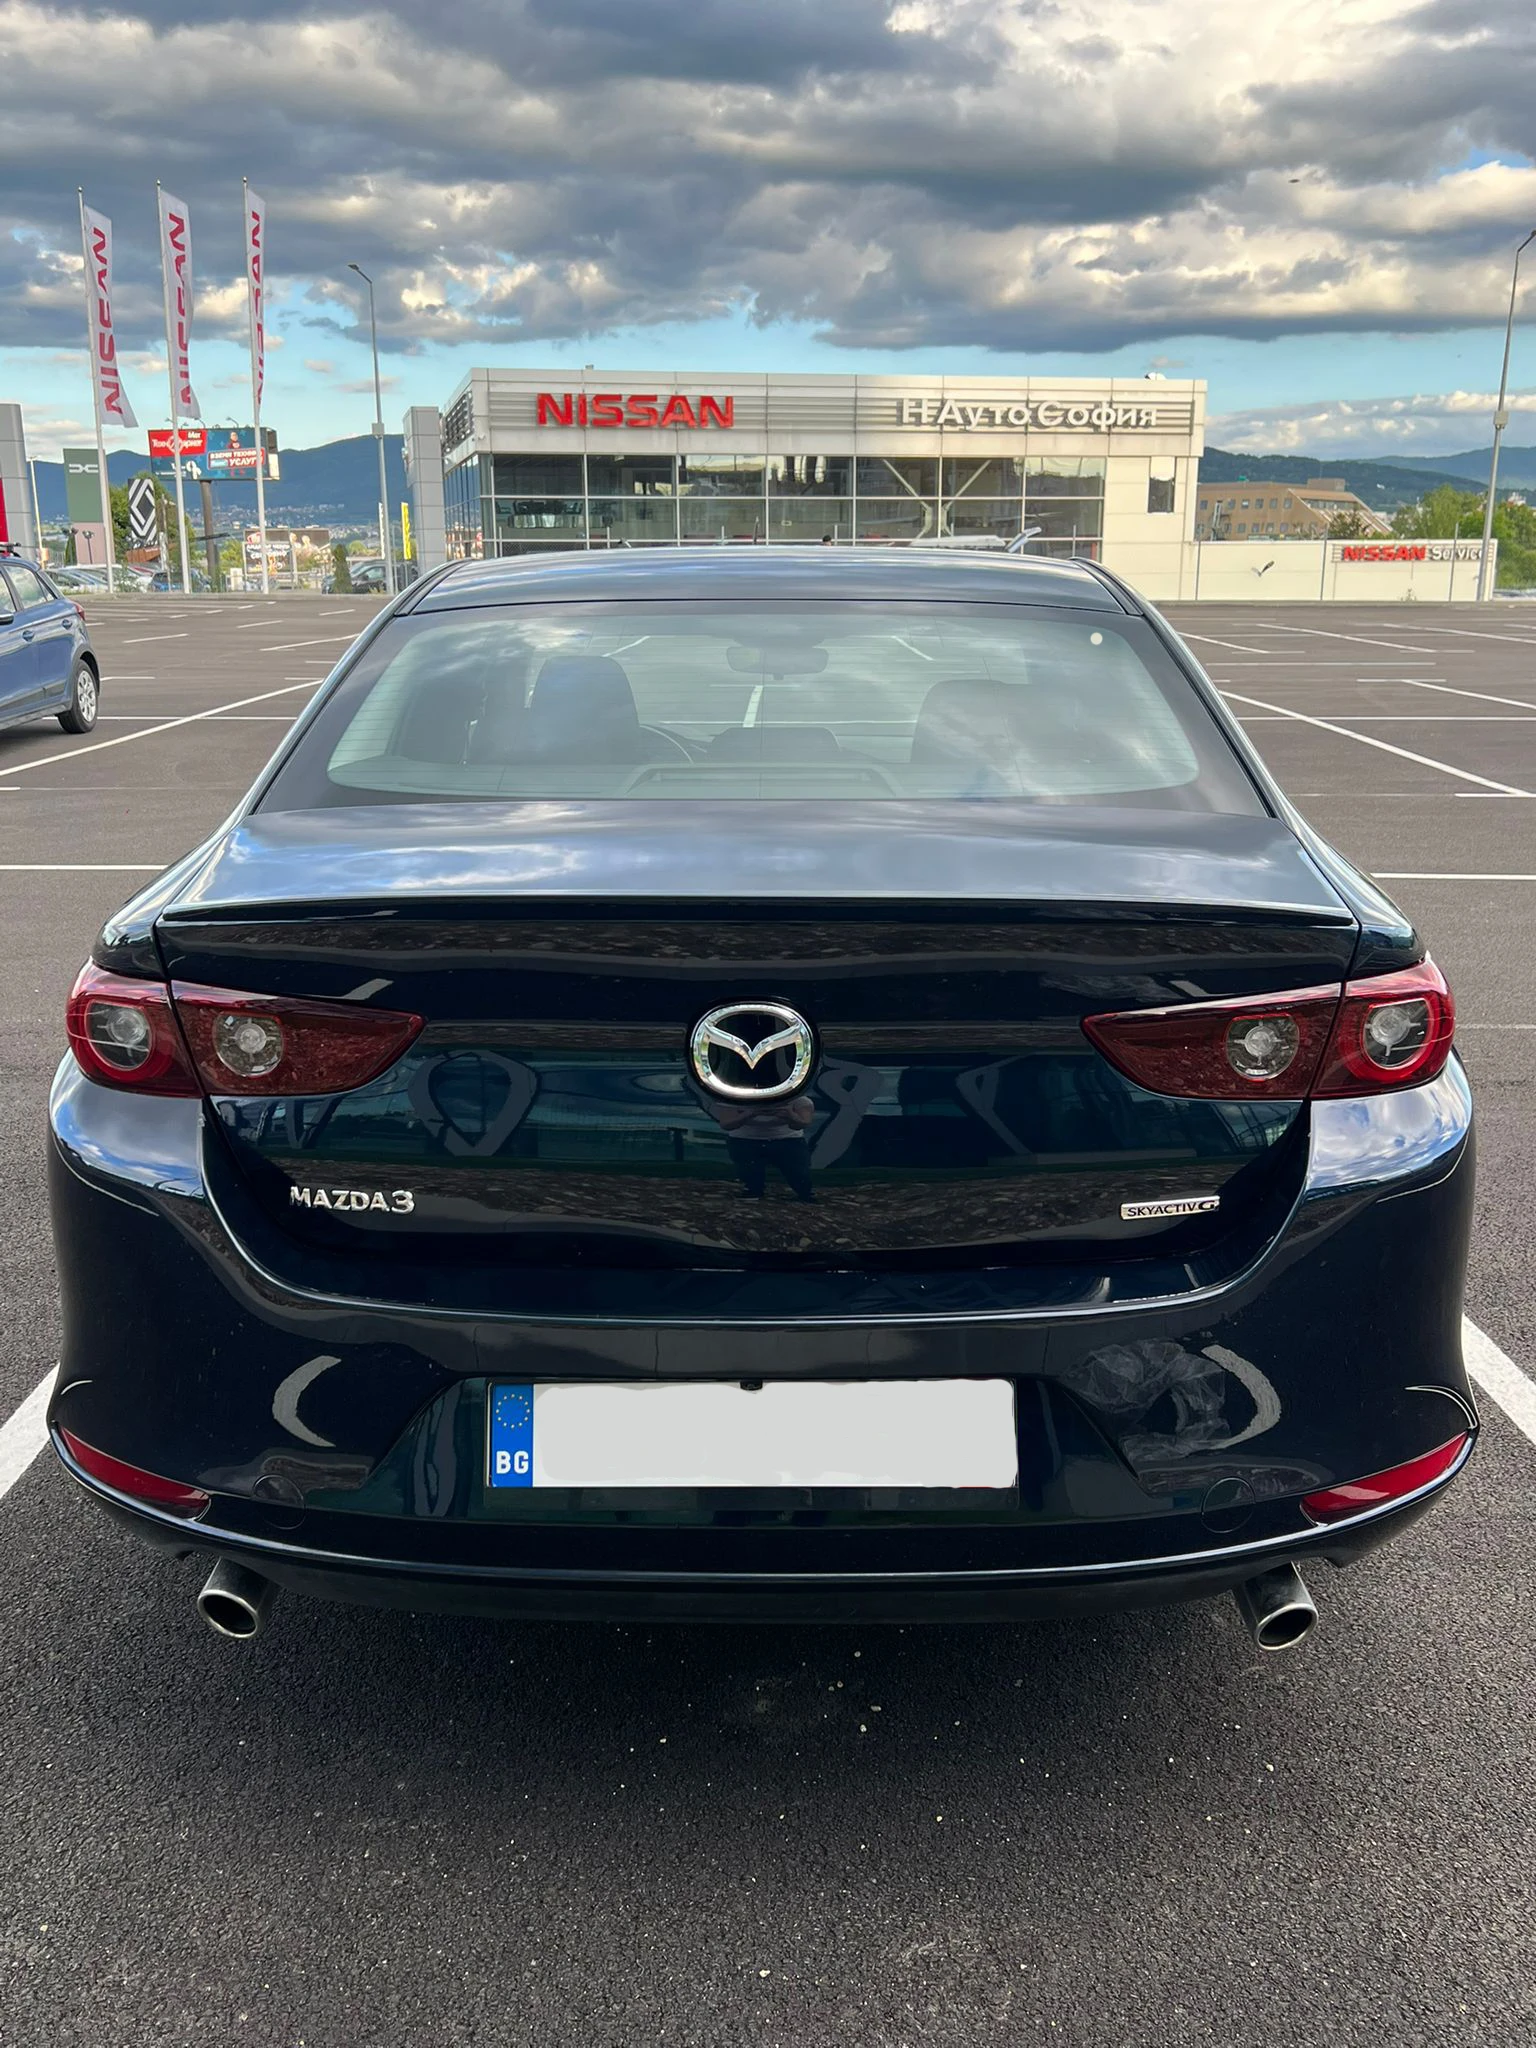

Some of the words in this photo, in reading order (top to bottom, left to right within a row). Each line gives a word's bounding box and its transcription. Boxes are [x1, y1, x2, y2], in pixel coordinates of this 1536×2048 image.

[92, 226, 124, 415] NISSAN
[537, 393, 734, 428] NISSAN
[1343, 544, 1426, 560] NISSAN
[496, 1450, 529, 1474] BG
